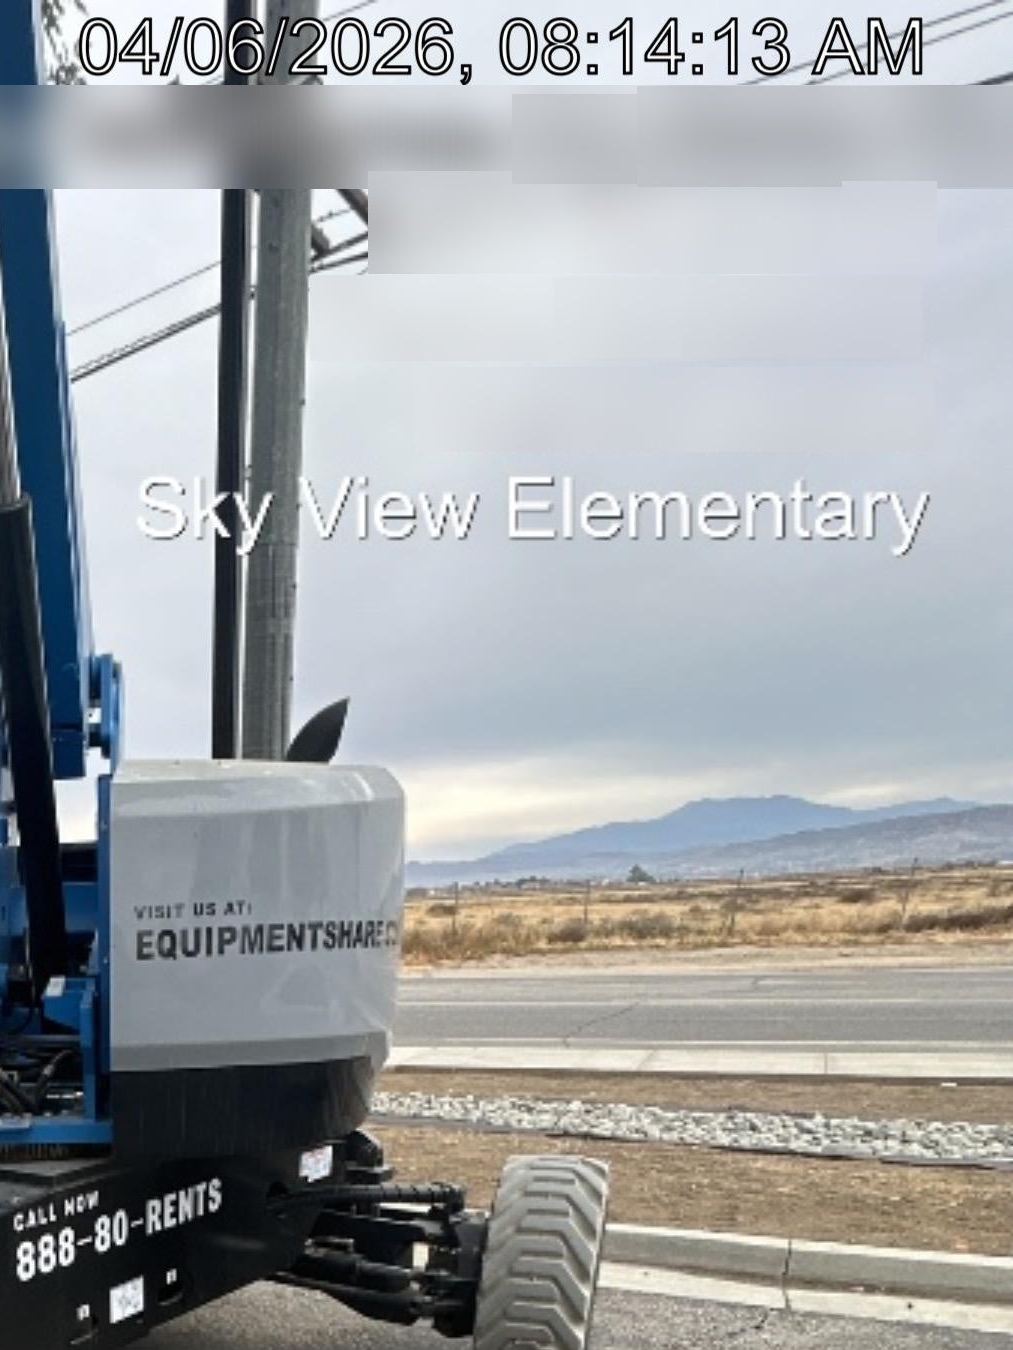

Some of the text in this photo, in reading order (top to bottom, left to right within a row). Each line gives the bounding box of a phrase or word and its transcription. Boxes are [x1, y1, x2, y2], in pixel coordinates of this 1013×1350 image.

[133, 902, 186, 920] VISIT
[192, 901, 217, 917] US
[13, 1189, 100, 1232] CALL NOW
